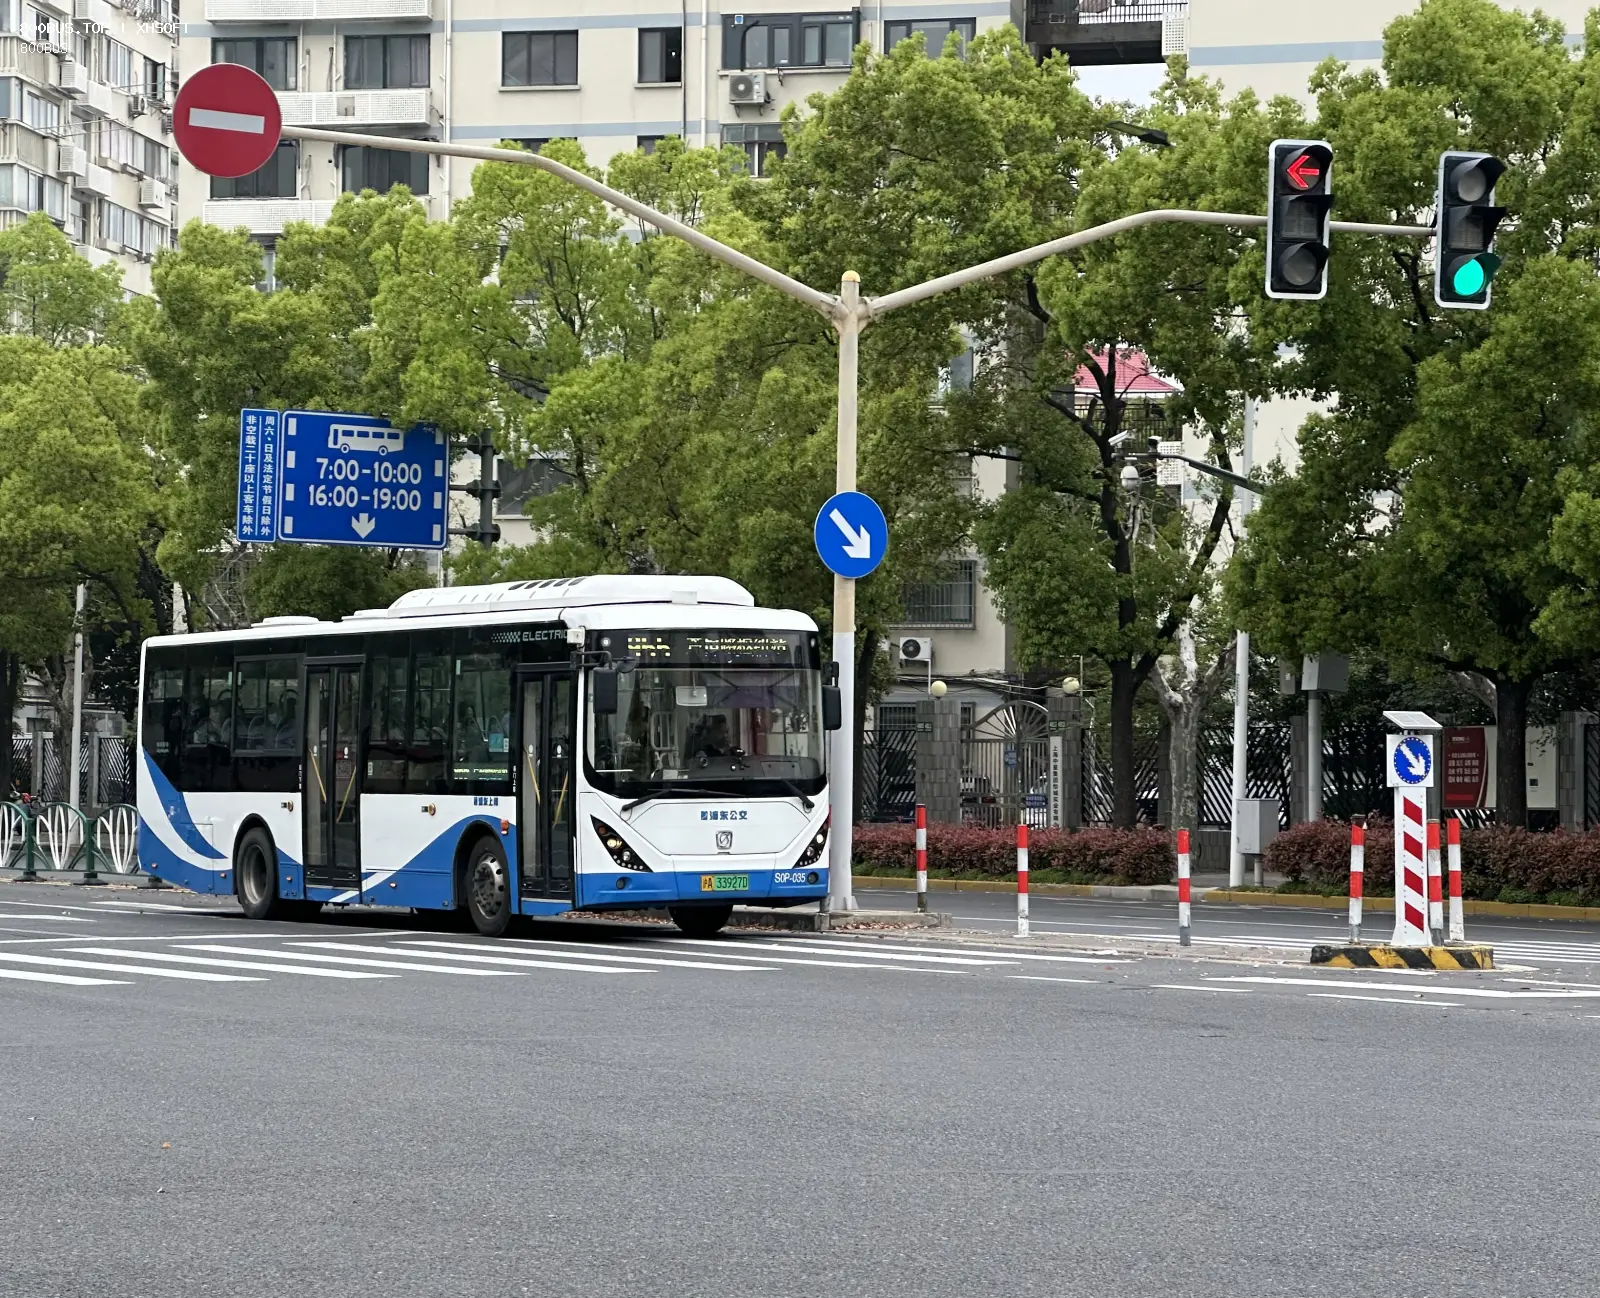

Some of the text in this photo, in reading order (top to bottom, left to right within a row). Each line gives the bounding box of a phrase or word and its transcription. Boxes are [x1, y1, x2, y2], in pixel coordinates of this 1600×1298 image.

[242, 415, 257, 536] 非空载二十座以上客车除外
[260, 416, 275, 536] 周六、日及法定节假日除外
[316, 457, 422, 485] 7:00-10:00
[308, 484, 422, 511] 16:00-19:00
[709, 810, 748, 820] 浦东公交
